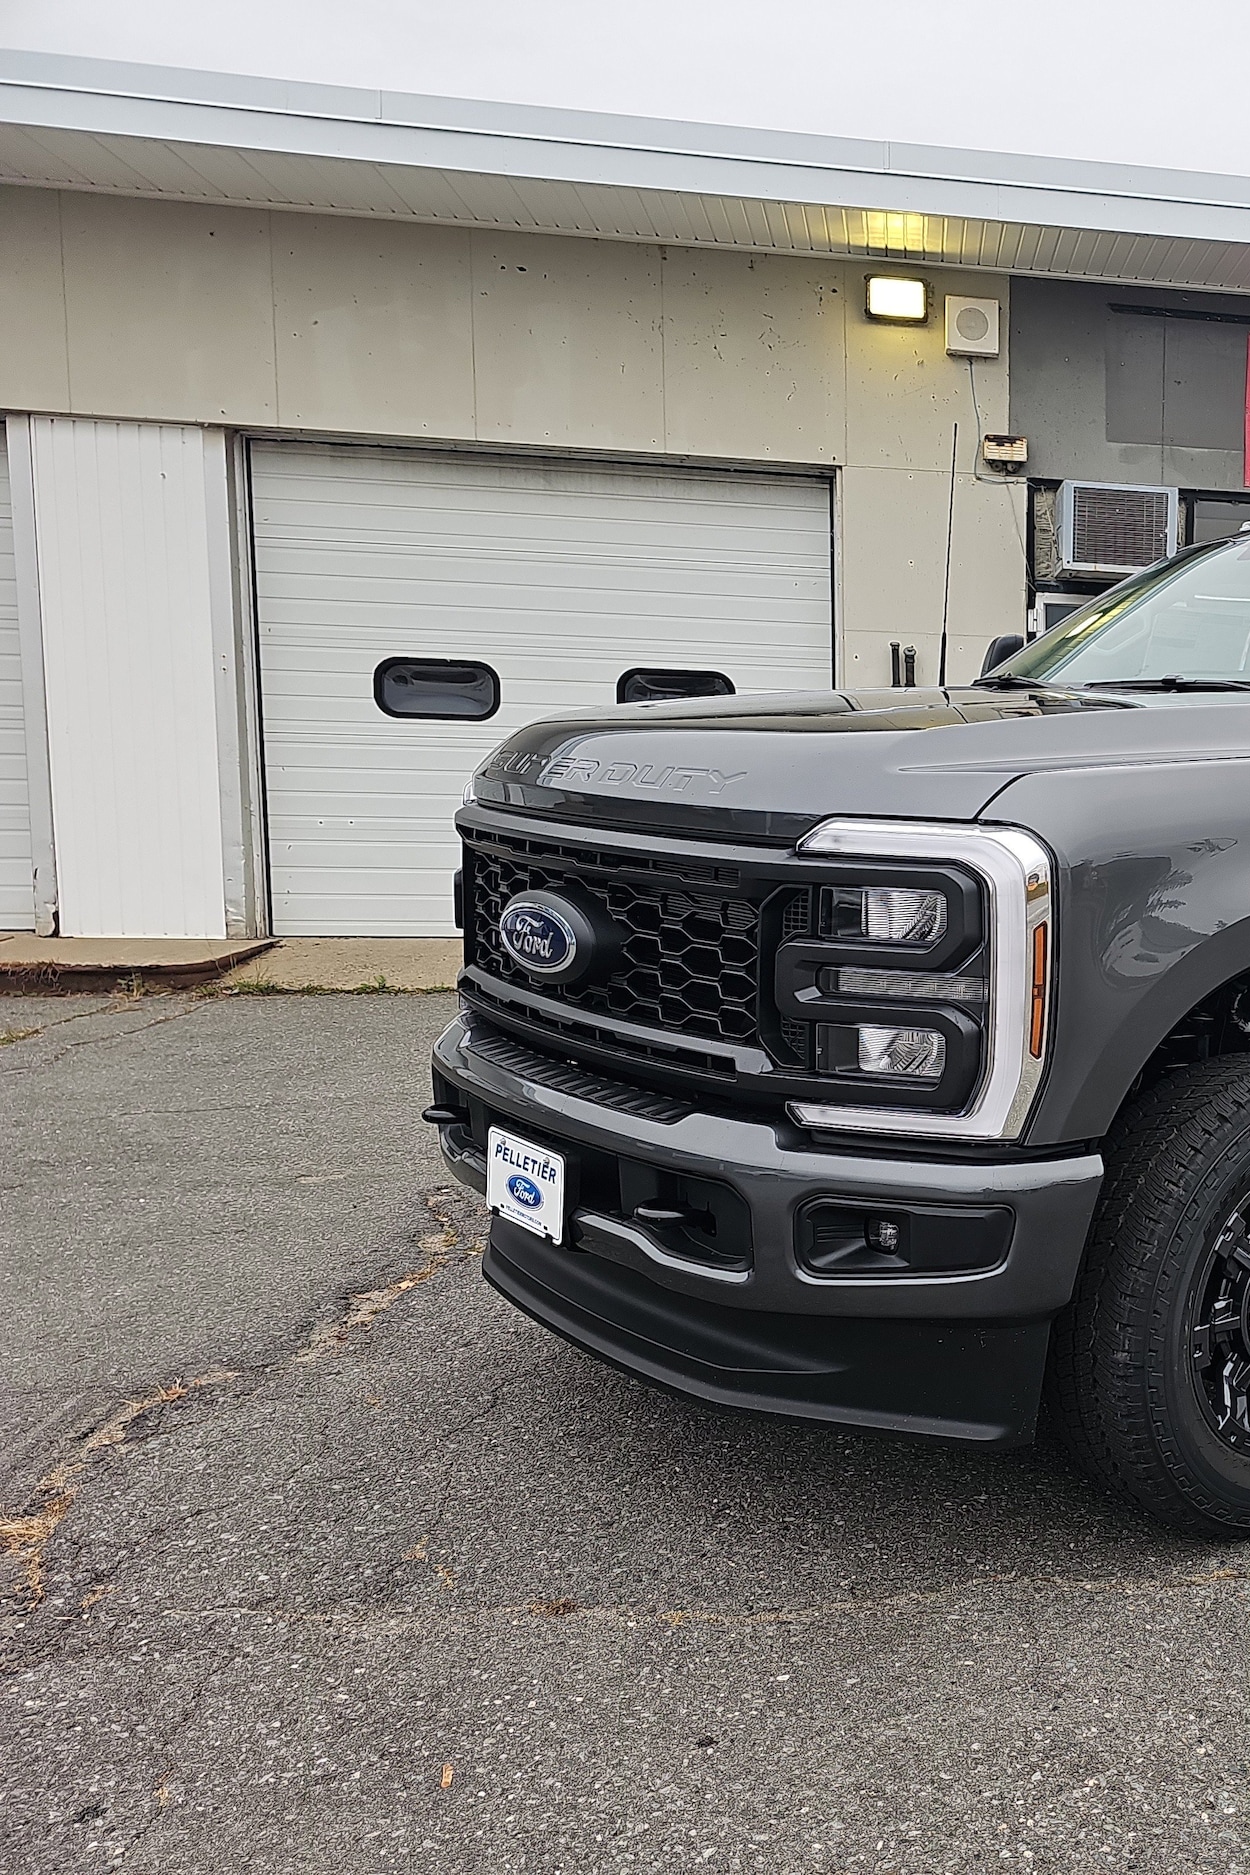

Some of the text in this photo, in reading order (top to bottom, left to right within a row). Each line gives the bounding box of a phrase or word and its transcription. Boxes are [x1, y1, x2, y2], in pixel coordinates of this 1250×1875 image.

[486, 750, 749, 794] SUPER DUTY
[512, 914, 554, 959] Ford
[494, 1142, 558, 1185] PELLETIER
[513, 1178, 536, 1205] Ford
